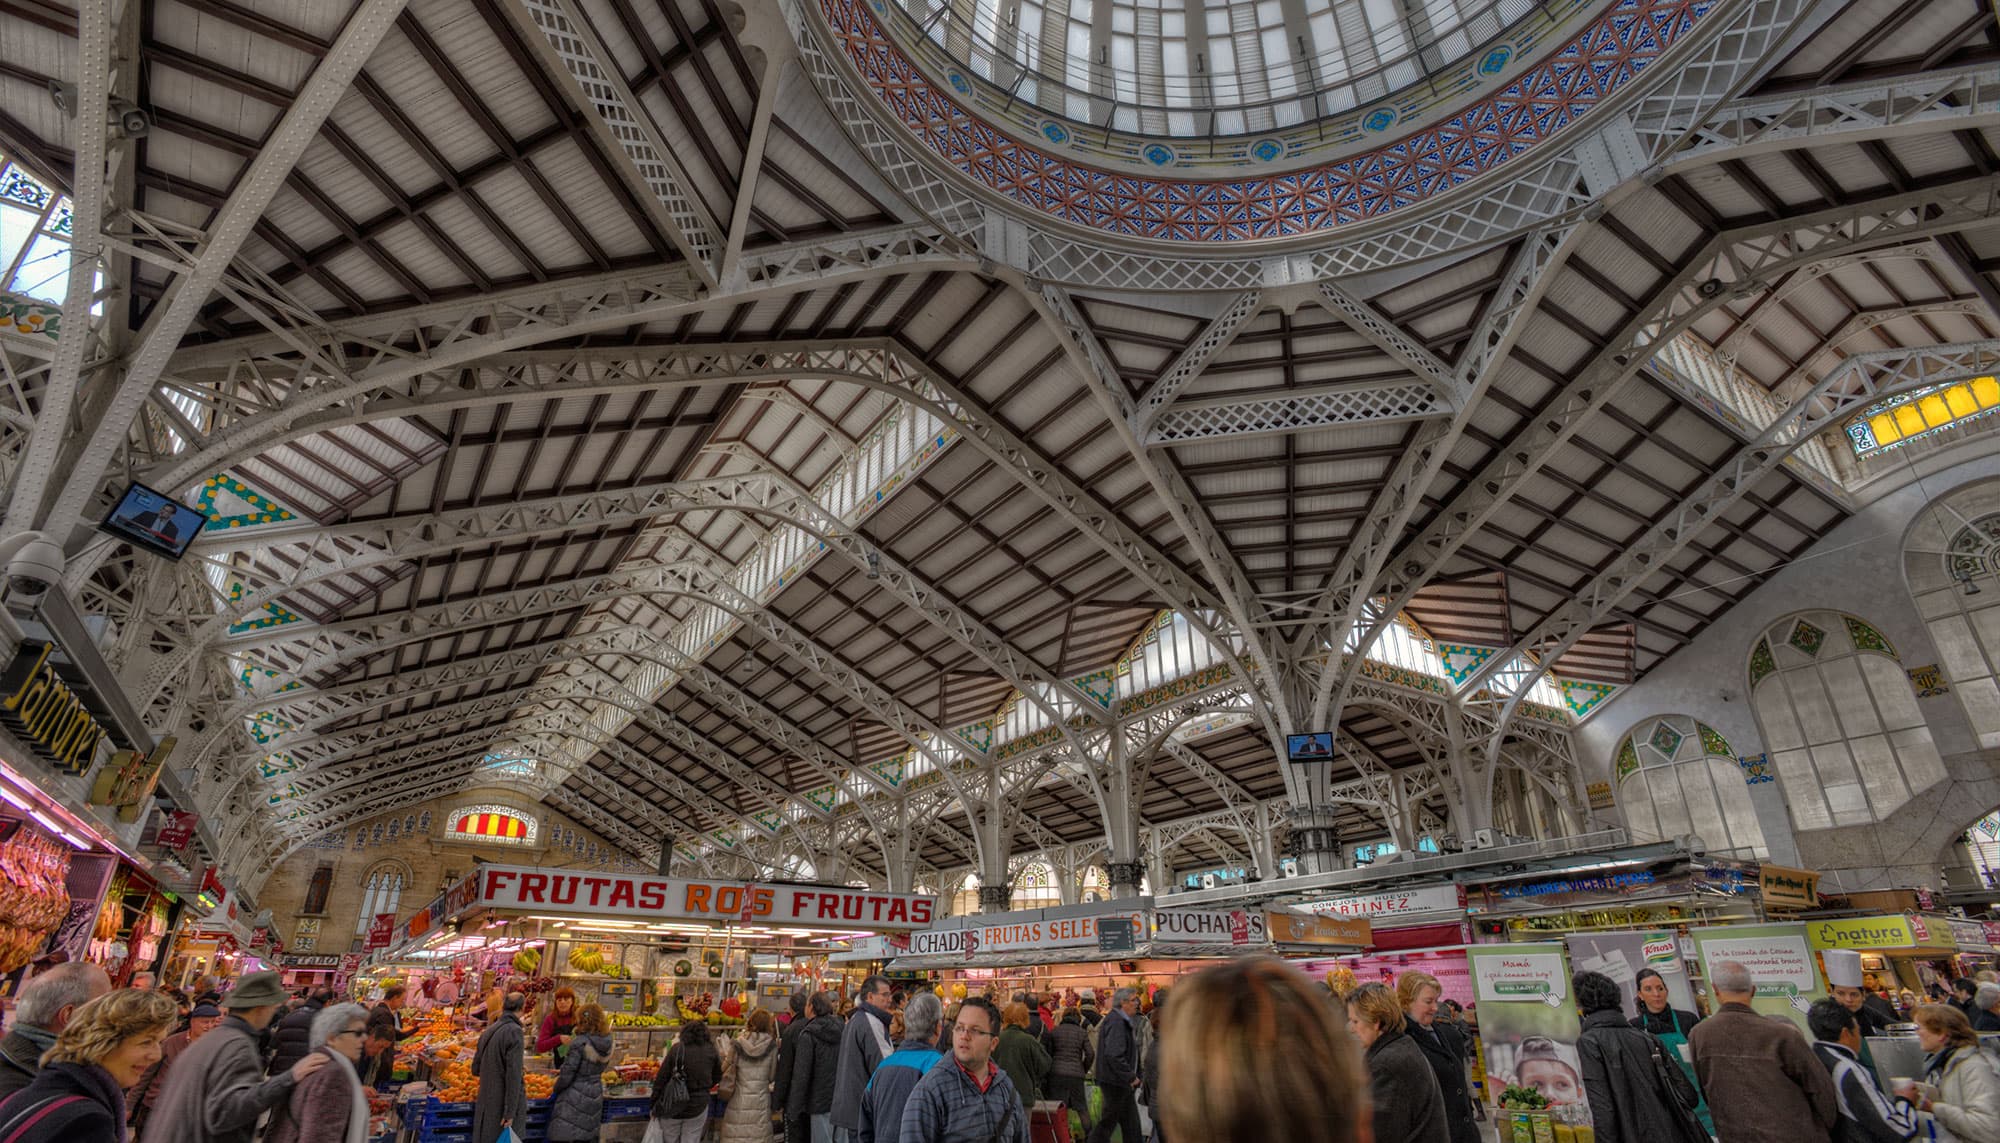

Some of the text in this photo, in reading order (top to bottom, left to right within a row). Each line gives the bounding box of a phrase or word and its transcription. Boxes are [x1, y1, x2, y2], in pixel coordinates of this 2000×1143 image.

[4, 641, 106, 777] Jamones
[484, 870, 668, 910] FRUTAS
[685, 884, 775, 916] ROS
[791, 891, 933, 923] FRUTAS
[1311, 891, 1418, 908] CONEJOS HUEVOS
[984, 922, 1041, 945] FRUTAS
[1836, 925, 1904, 942] natura
[1644, 942, 1674, 956] Knorr
